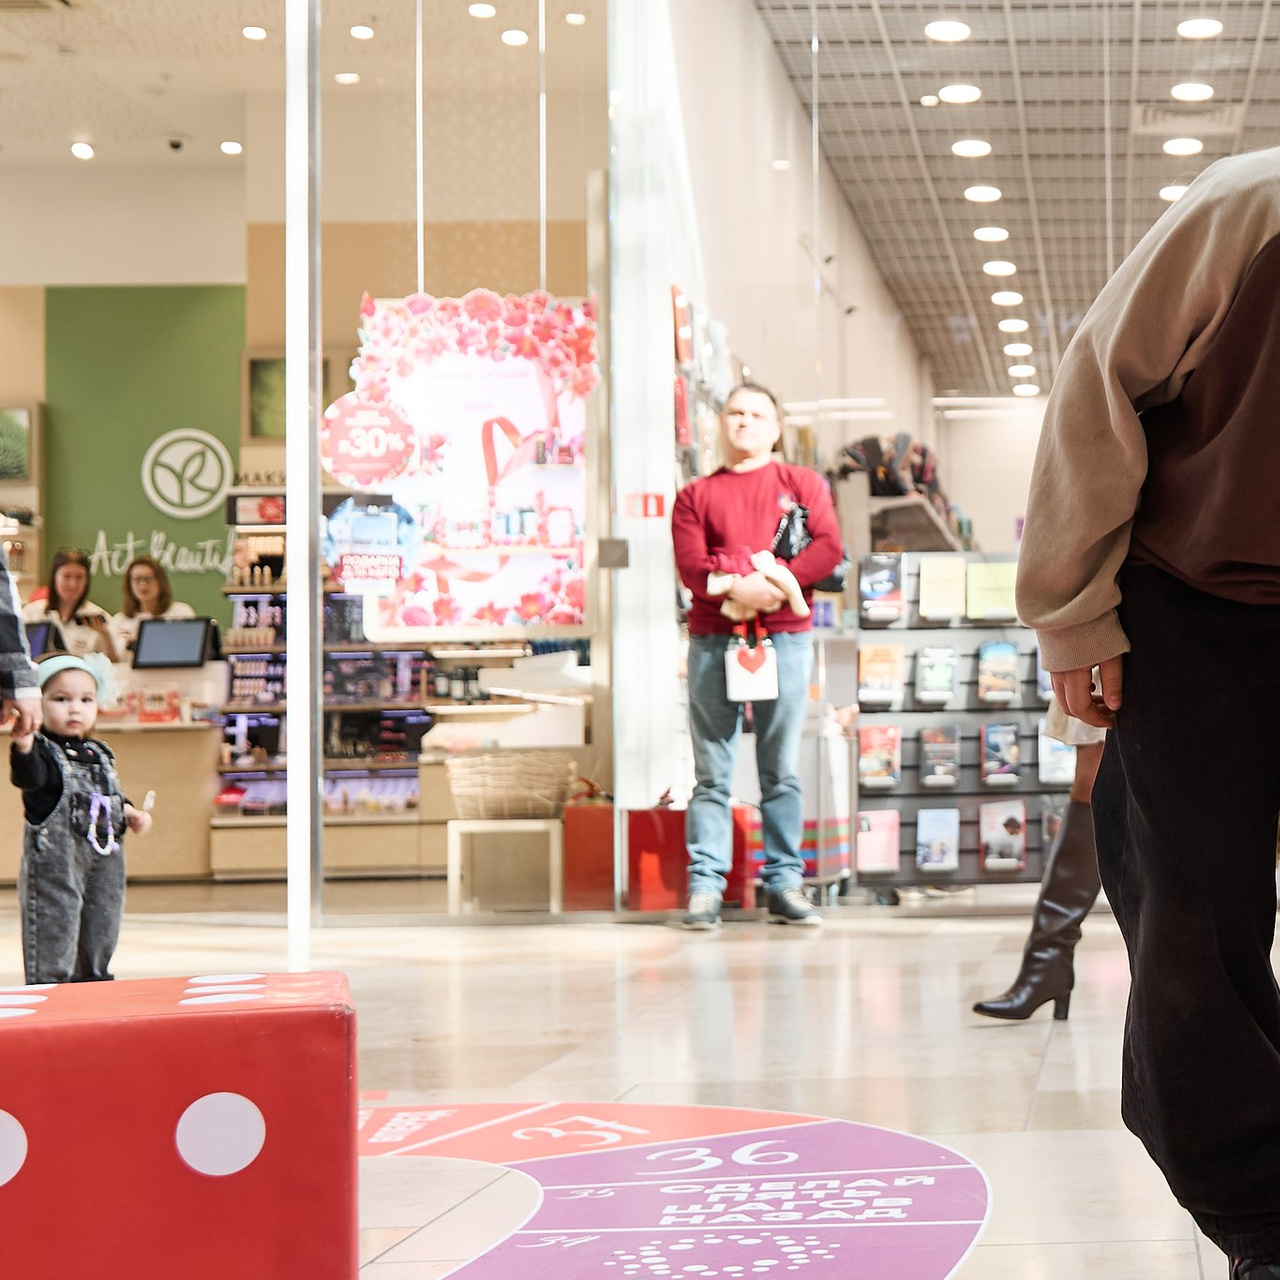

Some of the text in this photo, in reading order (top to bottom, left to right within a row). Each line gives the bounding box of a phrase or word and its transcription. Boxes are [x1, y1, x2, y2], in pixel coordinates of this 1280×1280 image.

[511, 1114, 650, 1148] 37
[635, 1139, 800, 1175] 36
[659, 1174, 936, 1194] СДЕЛАЙ
[554, 1187, 625, 1201] 35
[707, 1188, 882, 1203] ПЯТЬ
[661, 1197, 913, 1214] ШАГОВ
[657, 1207, 908, 1225] НАЗАД
[514, 1234, 602, 1249] 34
